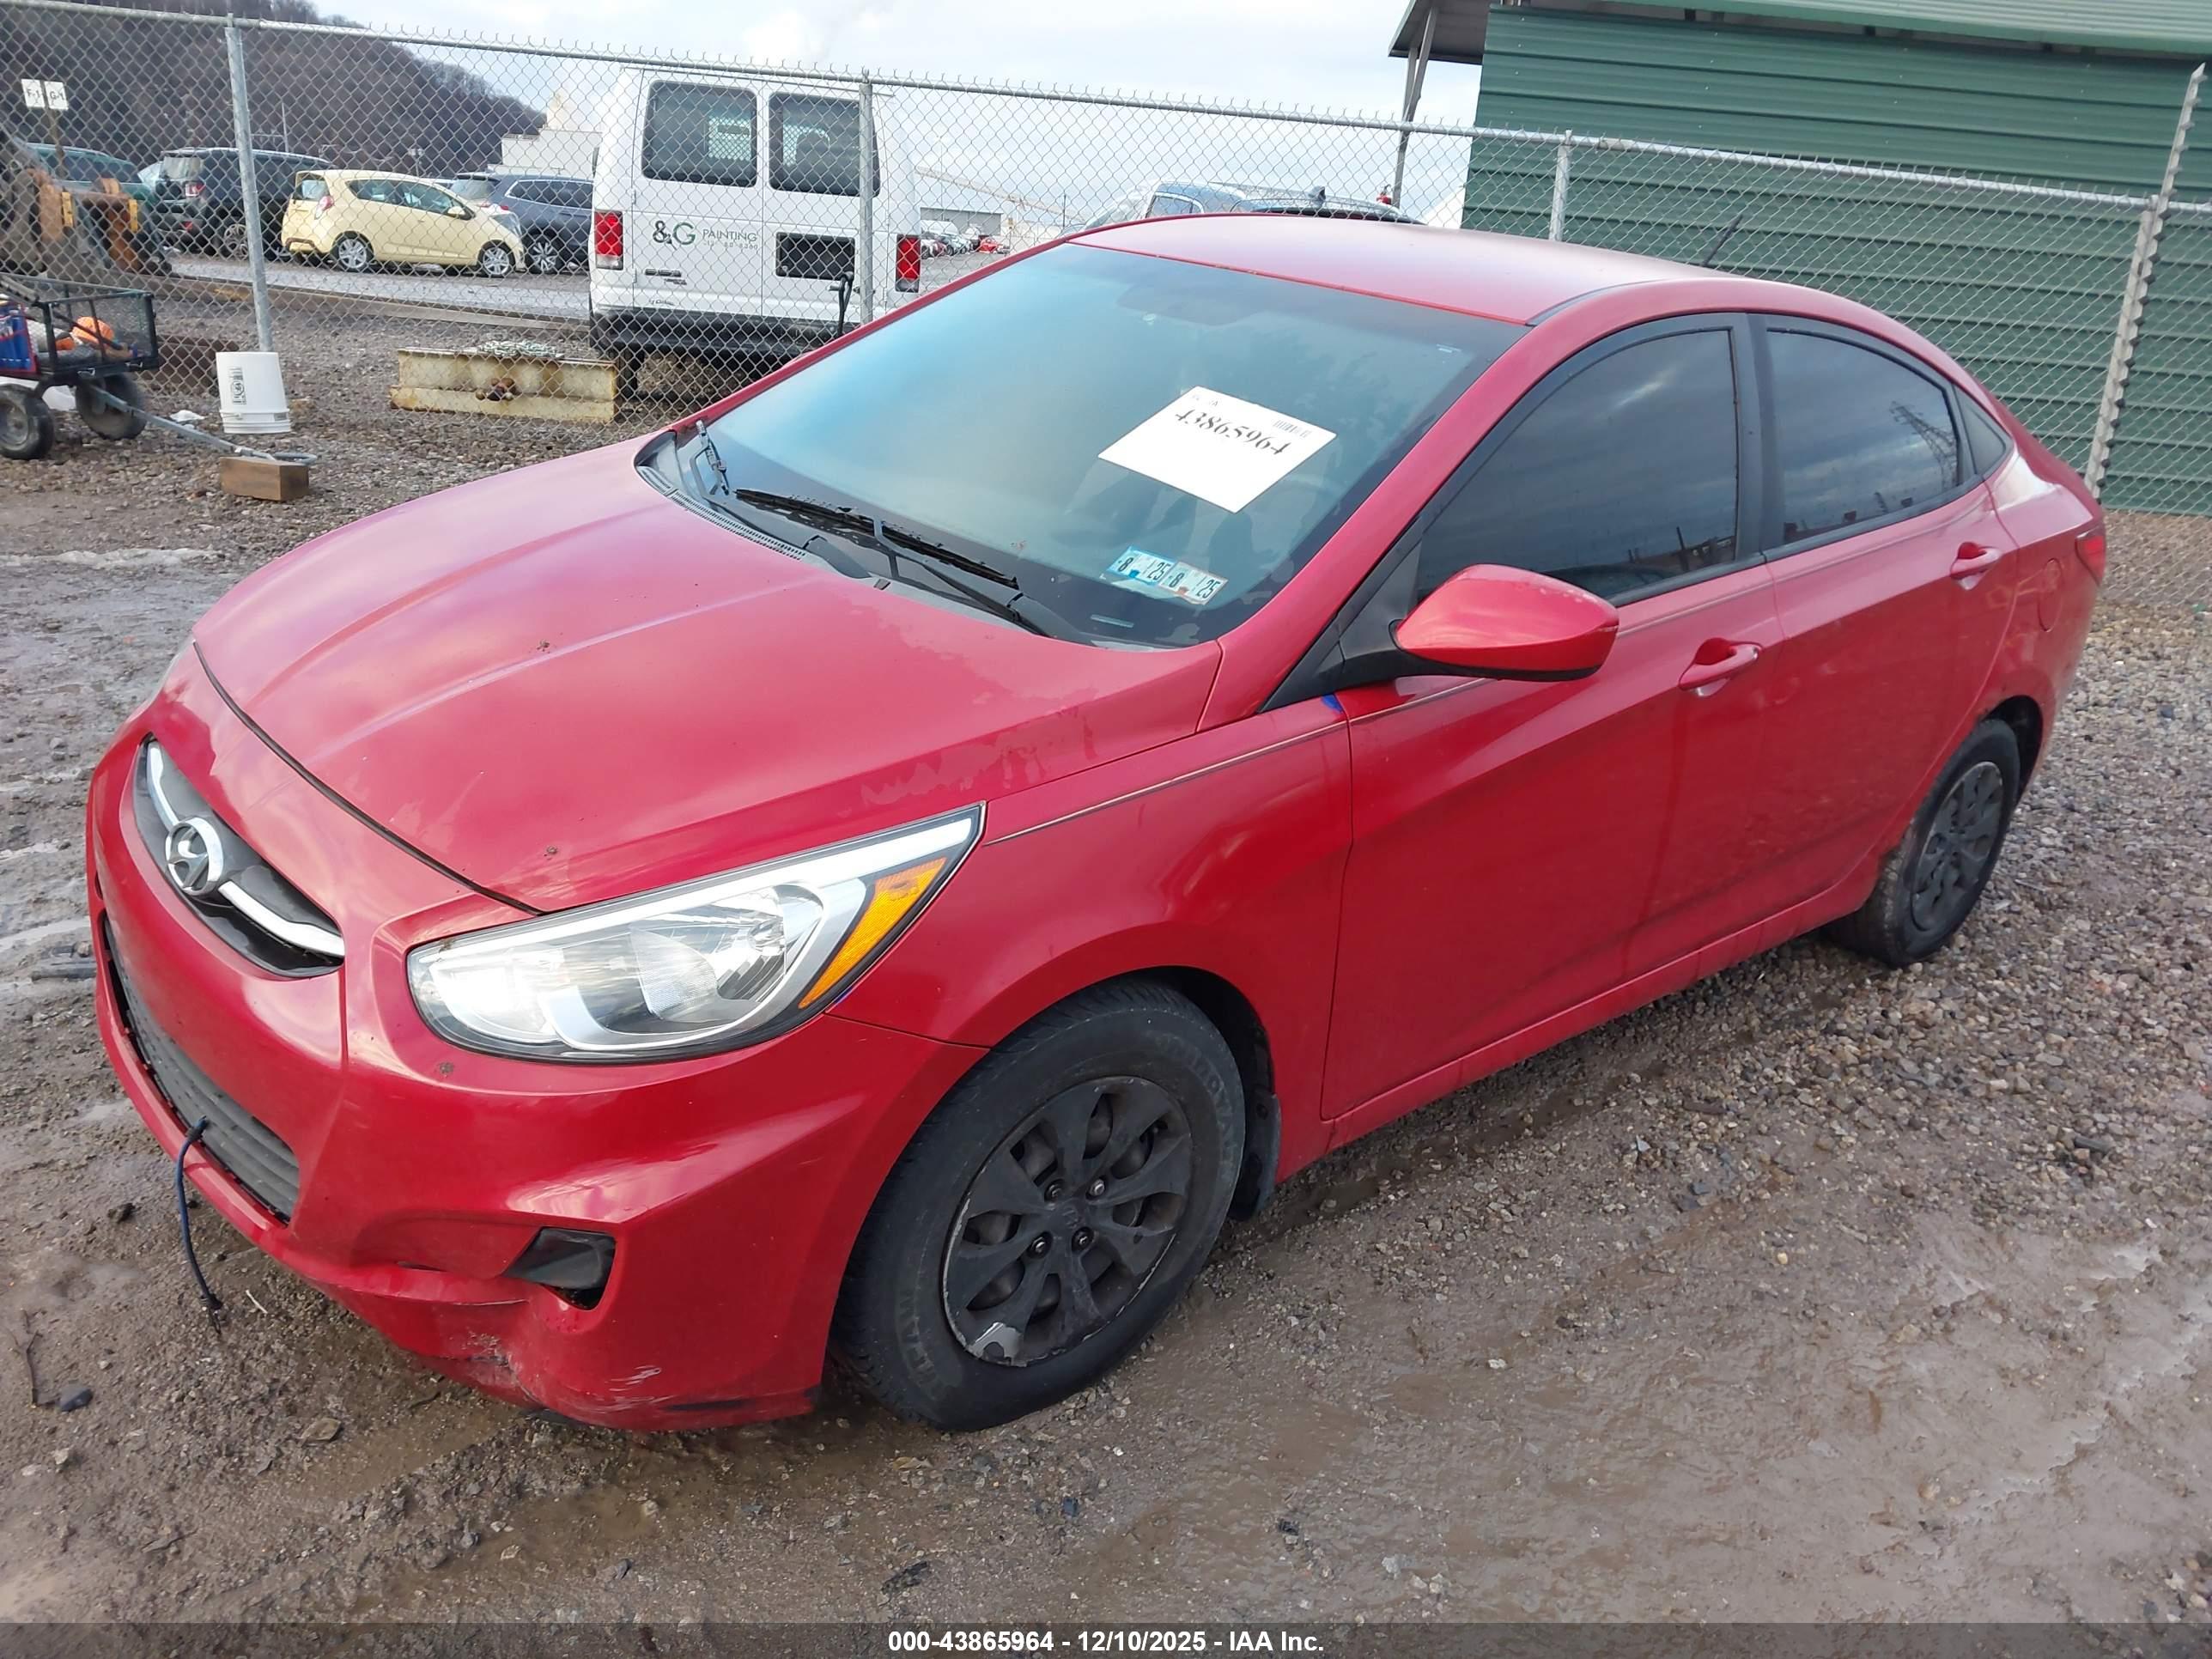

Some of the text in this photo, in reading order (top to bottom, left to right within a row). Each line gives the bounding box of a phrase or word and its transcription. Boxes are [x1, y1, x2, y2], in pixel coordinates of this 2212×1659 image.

[702, 228, 757, 241] PAINTING
[1174, 409, 1291, 455] 43865964
[1118, 556, 1170, 580] 8 25
[1169, 572, 1221, 599] 8 25
